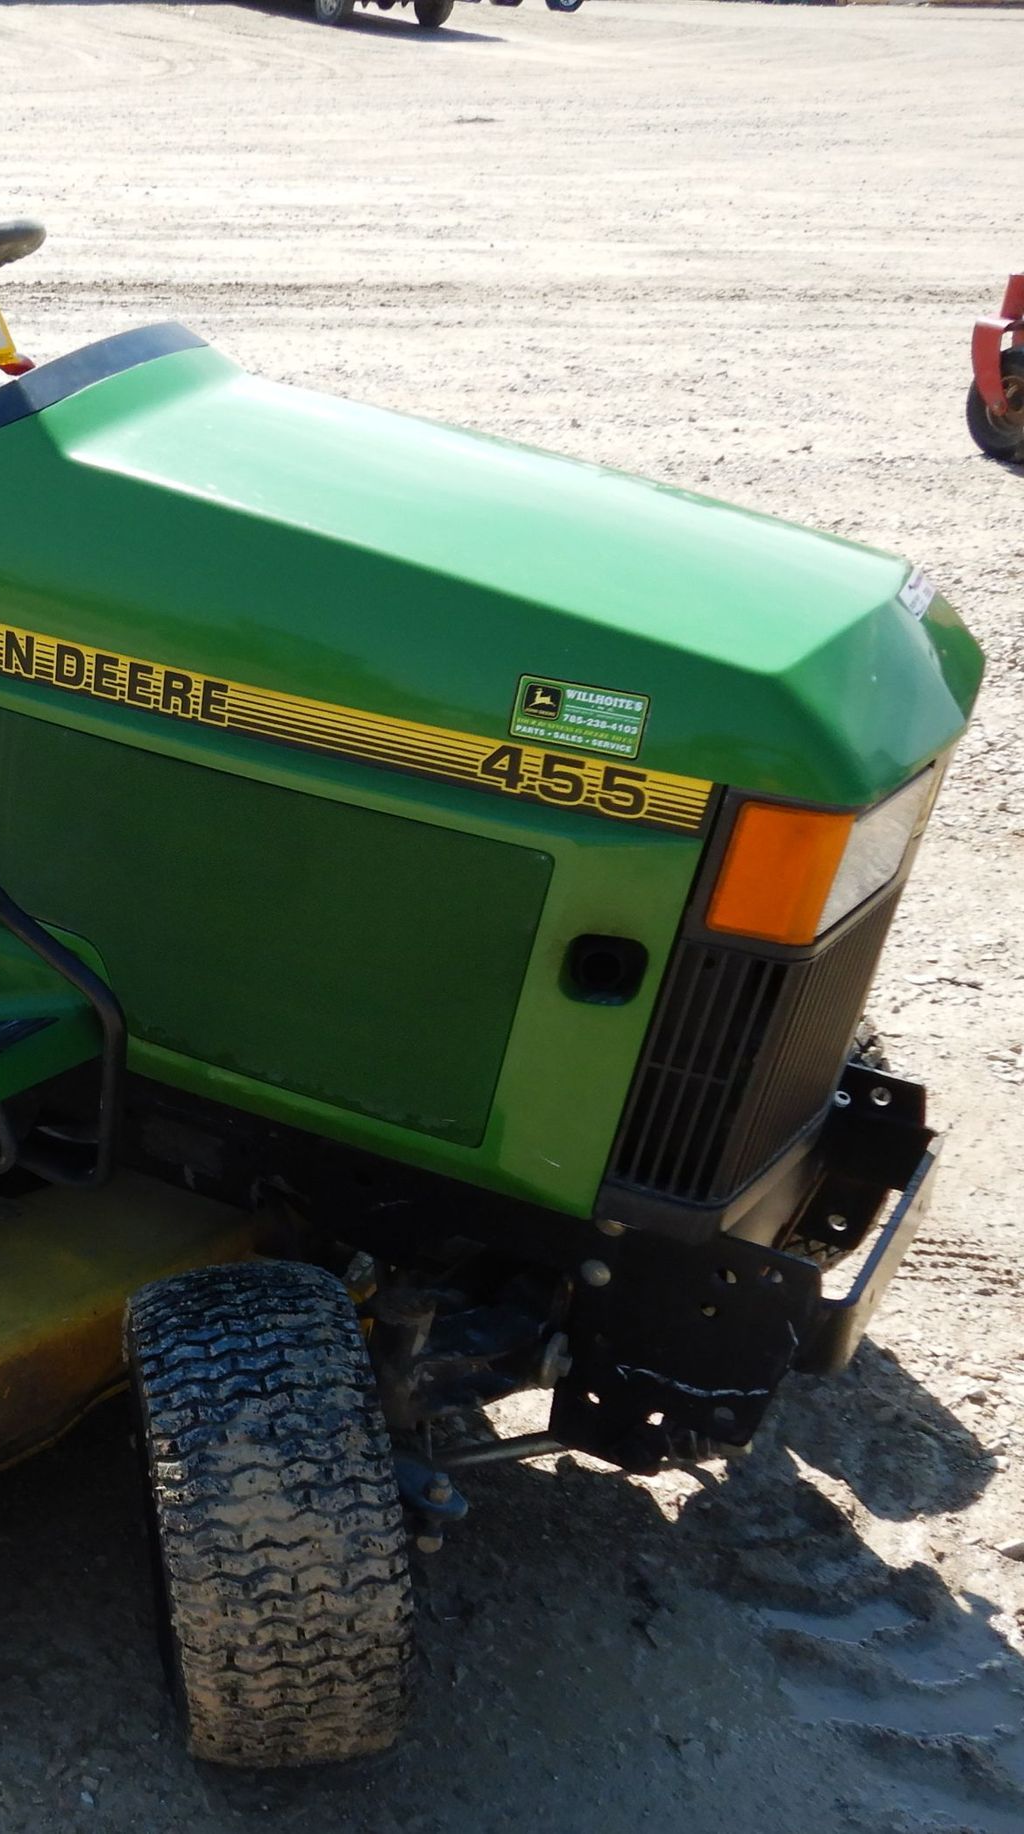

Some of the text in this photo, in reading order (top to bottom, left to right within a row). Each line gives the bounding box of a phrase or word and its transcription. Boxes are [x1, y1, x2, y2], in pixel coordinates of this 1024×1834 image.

[54, 643, 228, 726] DEERE
[516, 724, 545, 736] PARTS
[553, 731, 584, 744] SALES
[591, 738, 633, 753] SERVICE
[562, 713, 638, 735] 785-238-4103
[480, 744, 648, 817] 455
